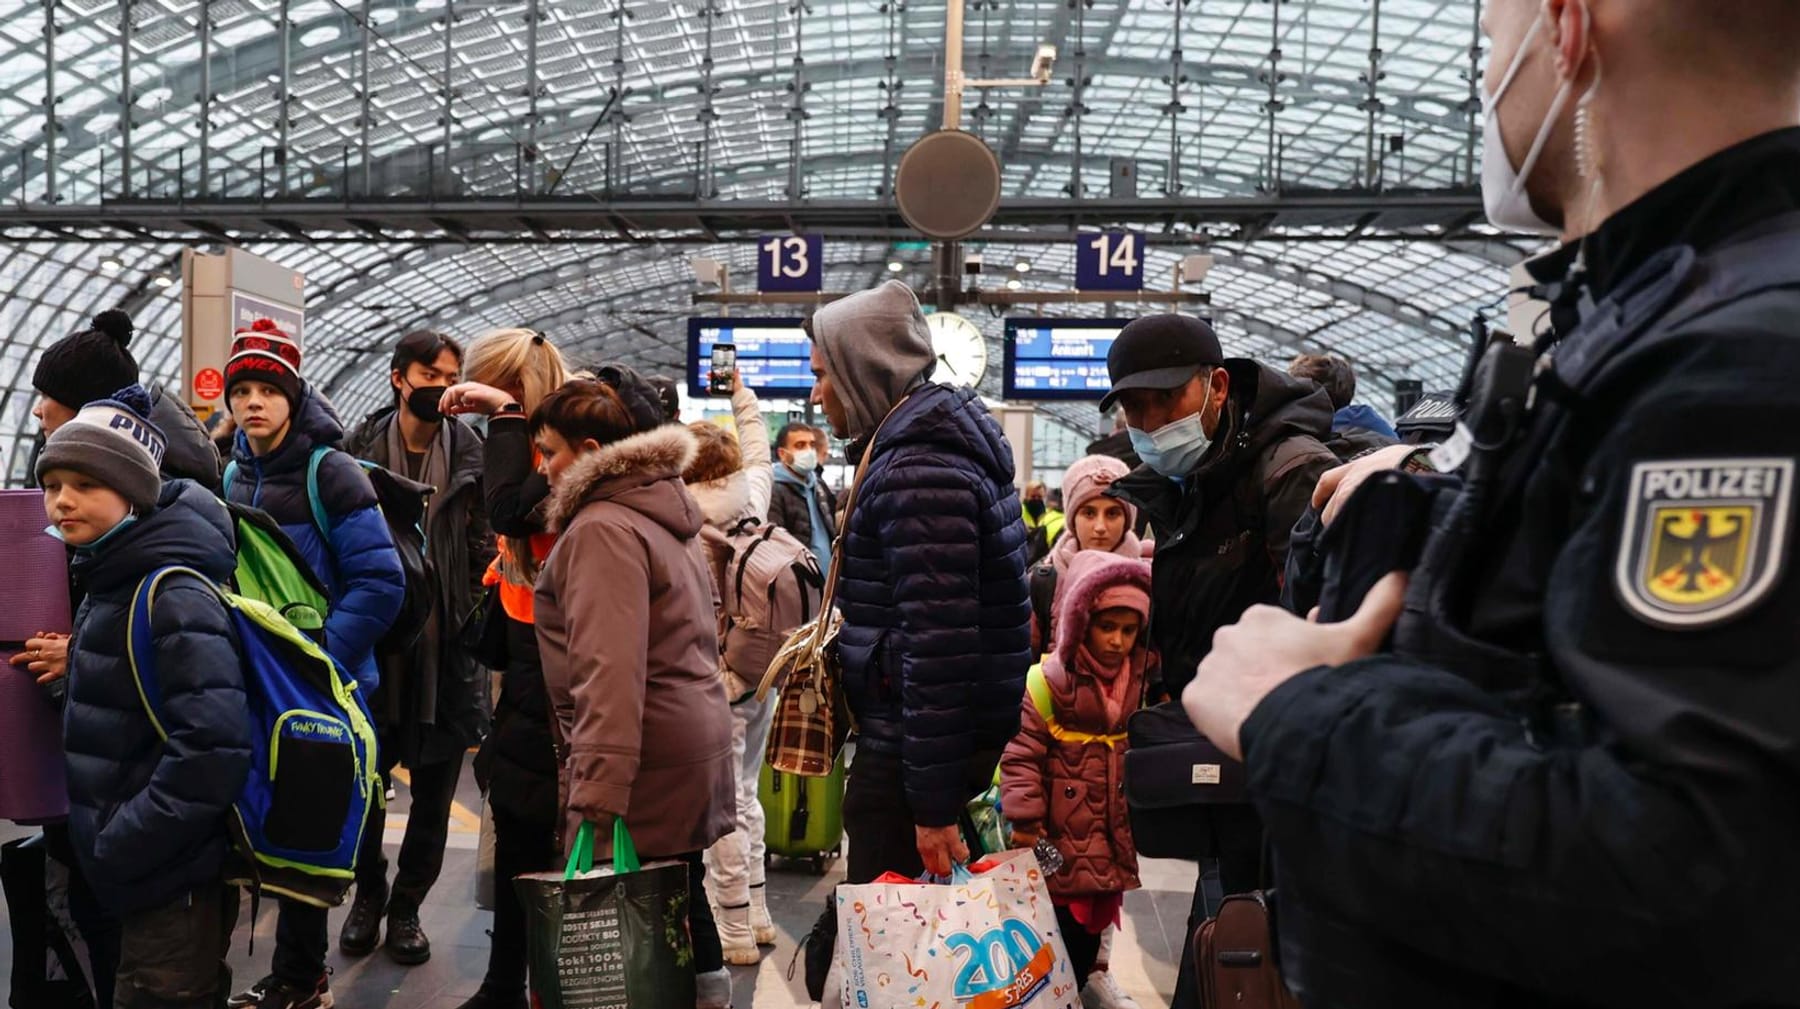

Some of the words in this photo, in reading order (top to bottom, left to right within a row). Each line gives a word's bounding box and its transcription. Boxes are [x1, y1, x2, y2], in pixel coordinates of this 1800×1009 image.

[764, 237, 808, 278] 13
[1091, 234, 1138, 276] 14
[1051, 343, 1094, 357] Ankunft
[109, 413, 163, 467] PUM
[1644, 467, 1776, 499] POLIZEI
[602, 930, 620, 939] BIO
[557, 956, 585, 966] Soki
[587, 952, 622, 963] 100%
[559, 963, 624, 976] naturalne
[944, 916, 1043, 999] 200
